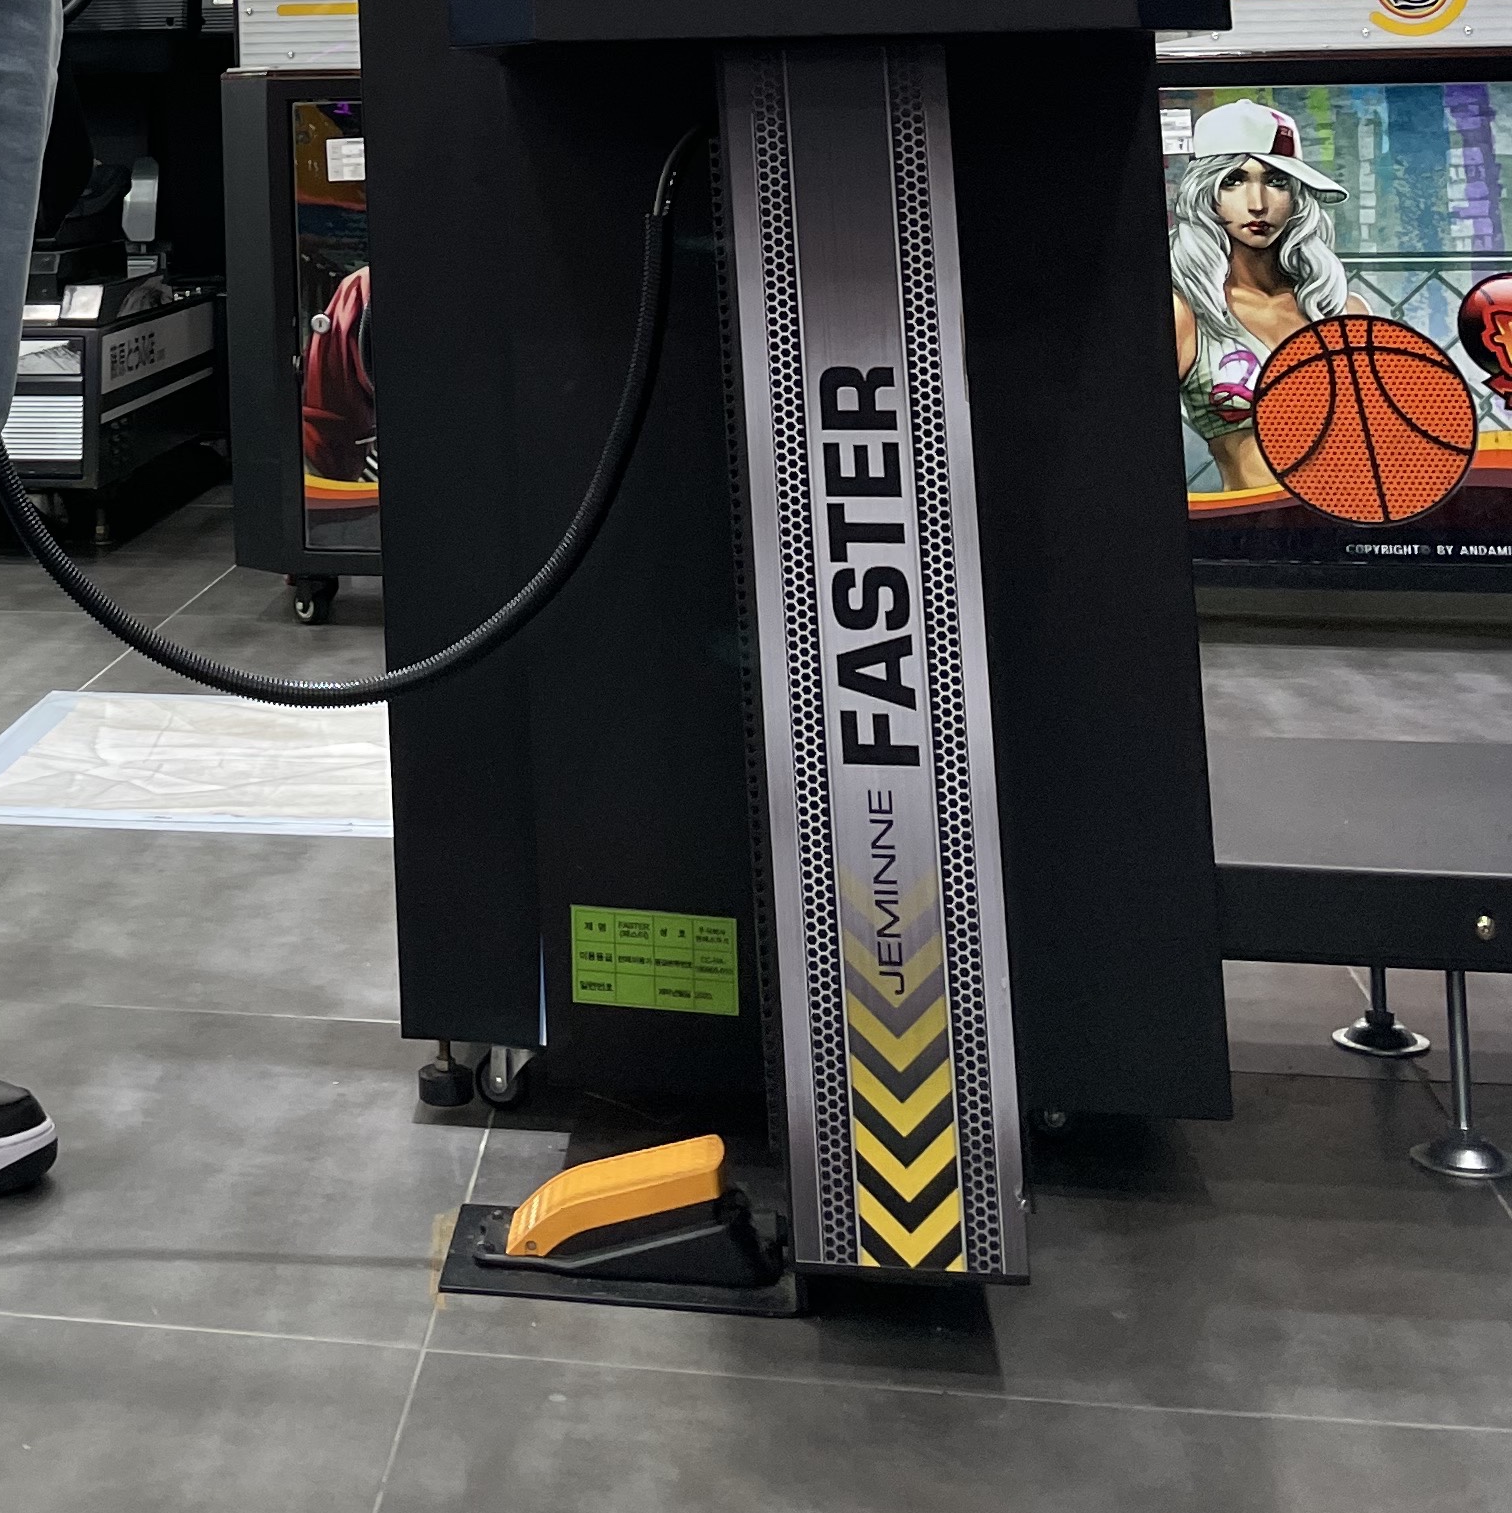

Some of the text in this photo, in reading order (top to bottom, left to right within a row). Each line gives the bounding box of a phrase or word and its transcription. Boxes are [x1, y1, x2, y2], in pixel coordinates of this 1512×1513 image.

[819, 365, 920, 768] FASTER
[1436, 545, 1454, 555] BY
[868, 789, 906, 996] JEMINNE
